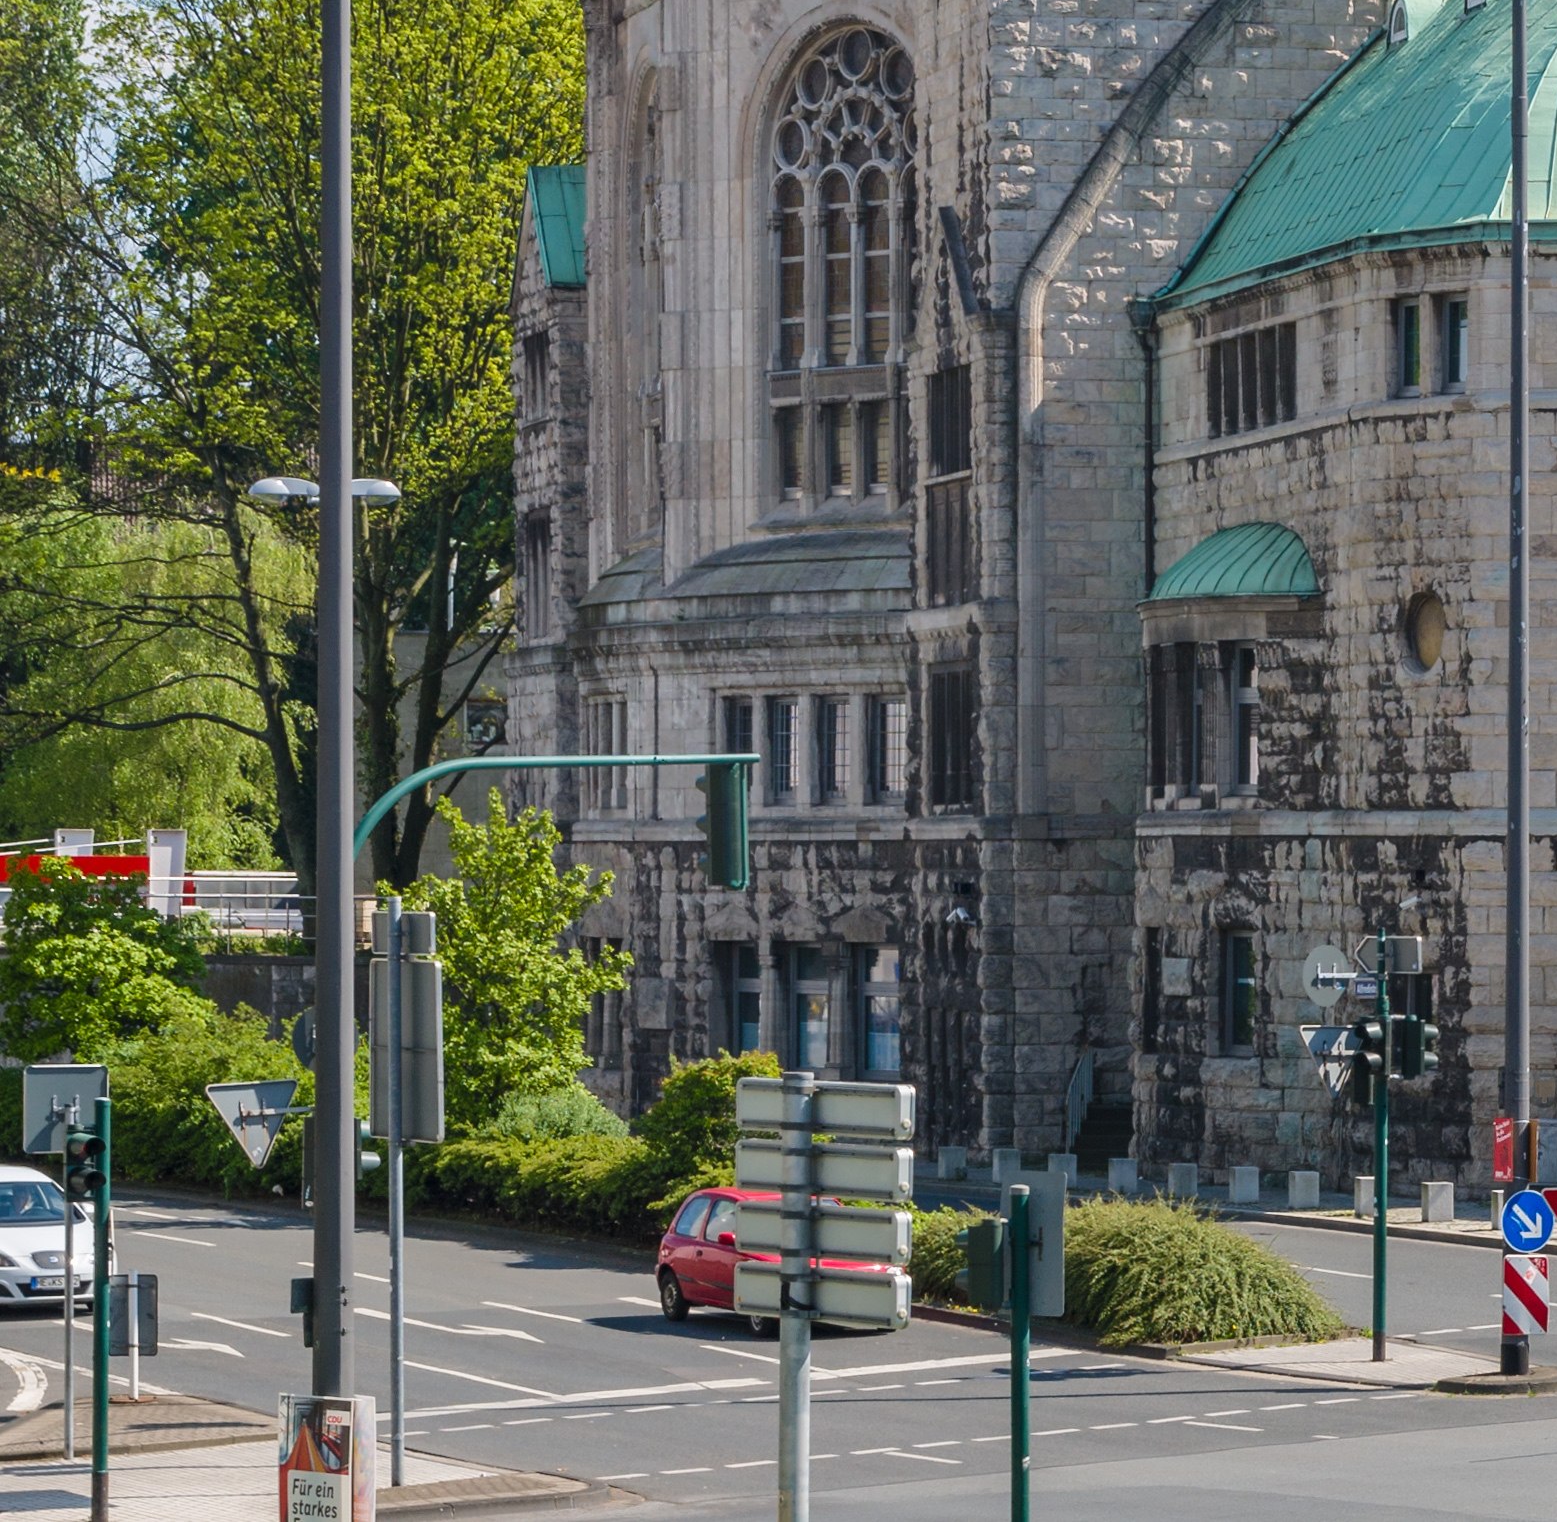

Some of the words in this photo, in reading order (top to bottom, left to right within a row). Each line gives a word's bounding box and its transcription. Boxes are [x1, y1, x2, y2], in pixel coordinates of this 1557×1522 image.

[327, 1415, 342, 1423] CDU
[292, 1478, 314, 1496] Für
[315, 1481, 334, 1499] ein
[292, 1499, 338, 1519] starkes
